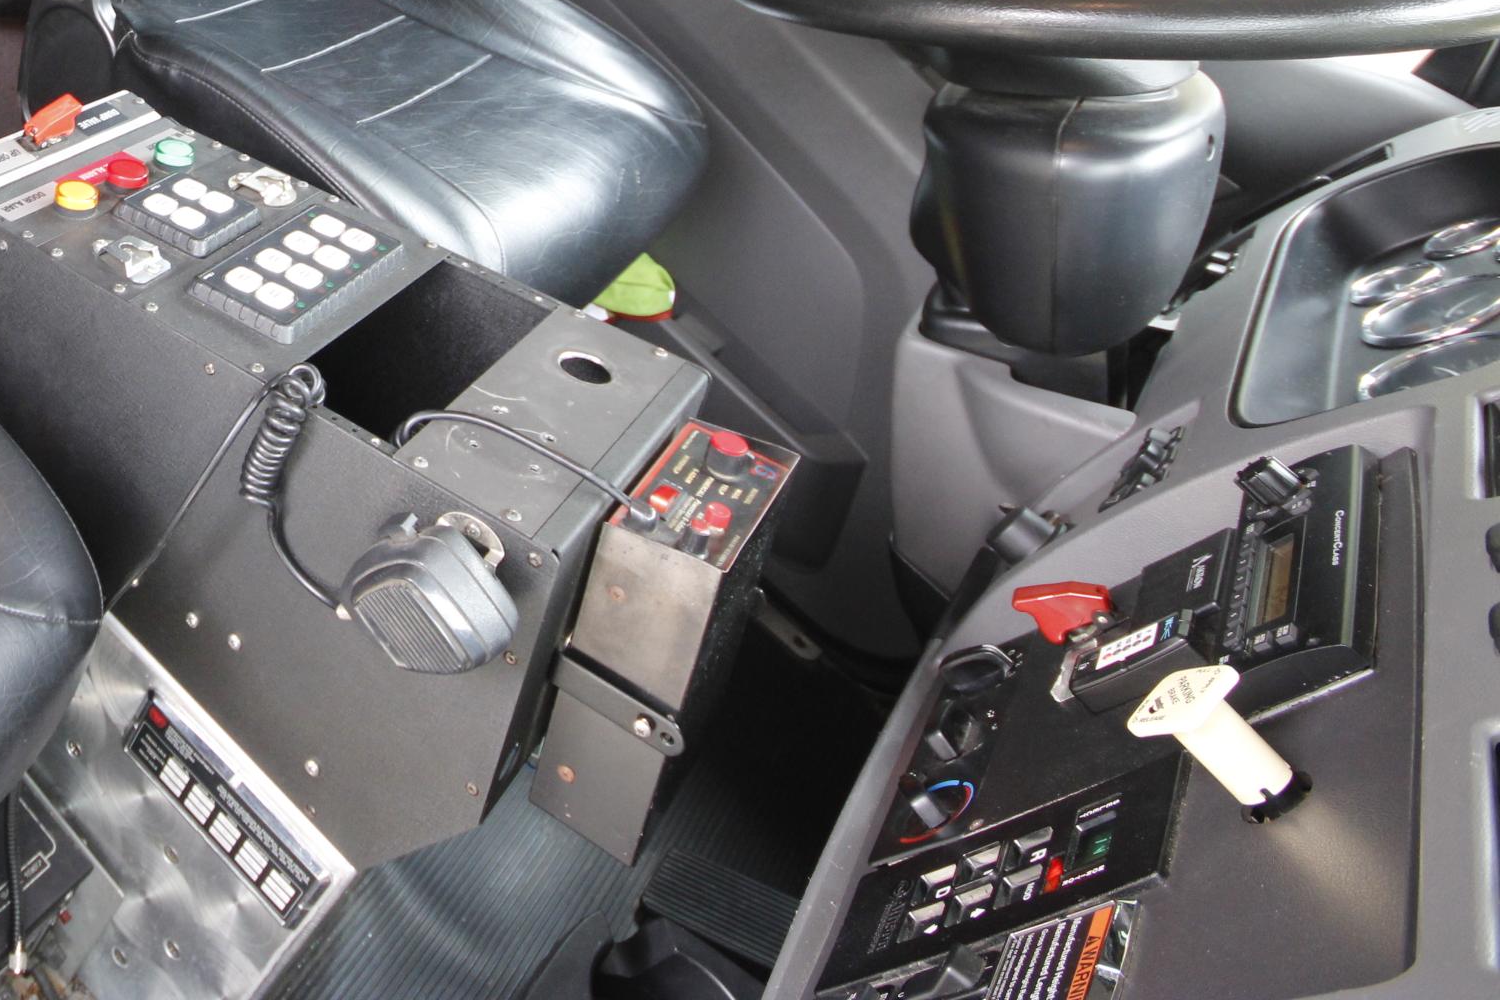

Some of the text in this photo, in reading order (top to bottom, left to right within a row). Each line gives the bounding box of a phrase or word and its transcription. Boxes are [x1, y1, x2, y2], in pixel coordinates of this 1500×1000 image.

[1180, 675, 1197, 705] PARKING
[1029, 847, 1048, 863] R
[935, 885, 952, 899] D
[1040, 921, 1067, 978] Manufactured
[1056, 916, 1083, 972] Manufactured
